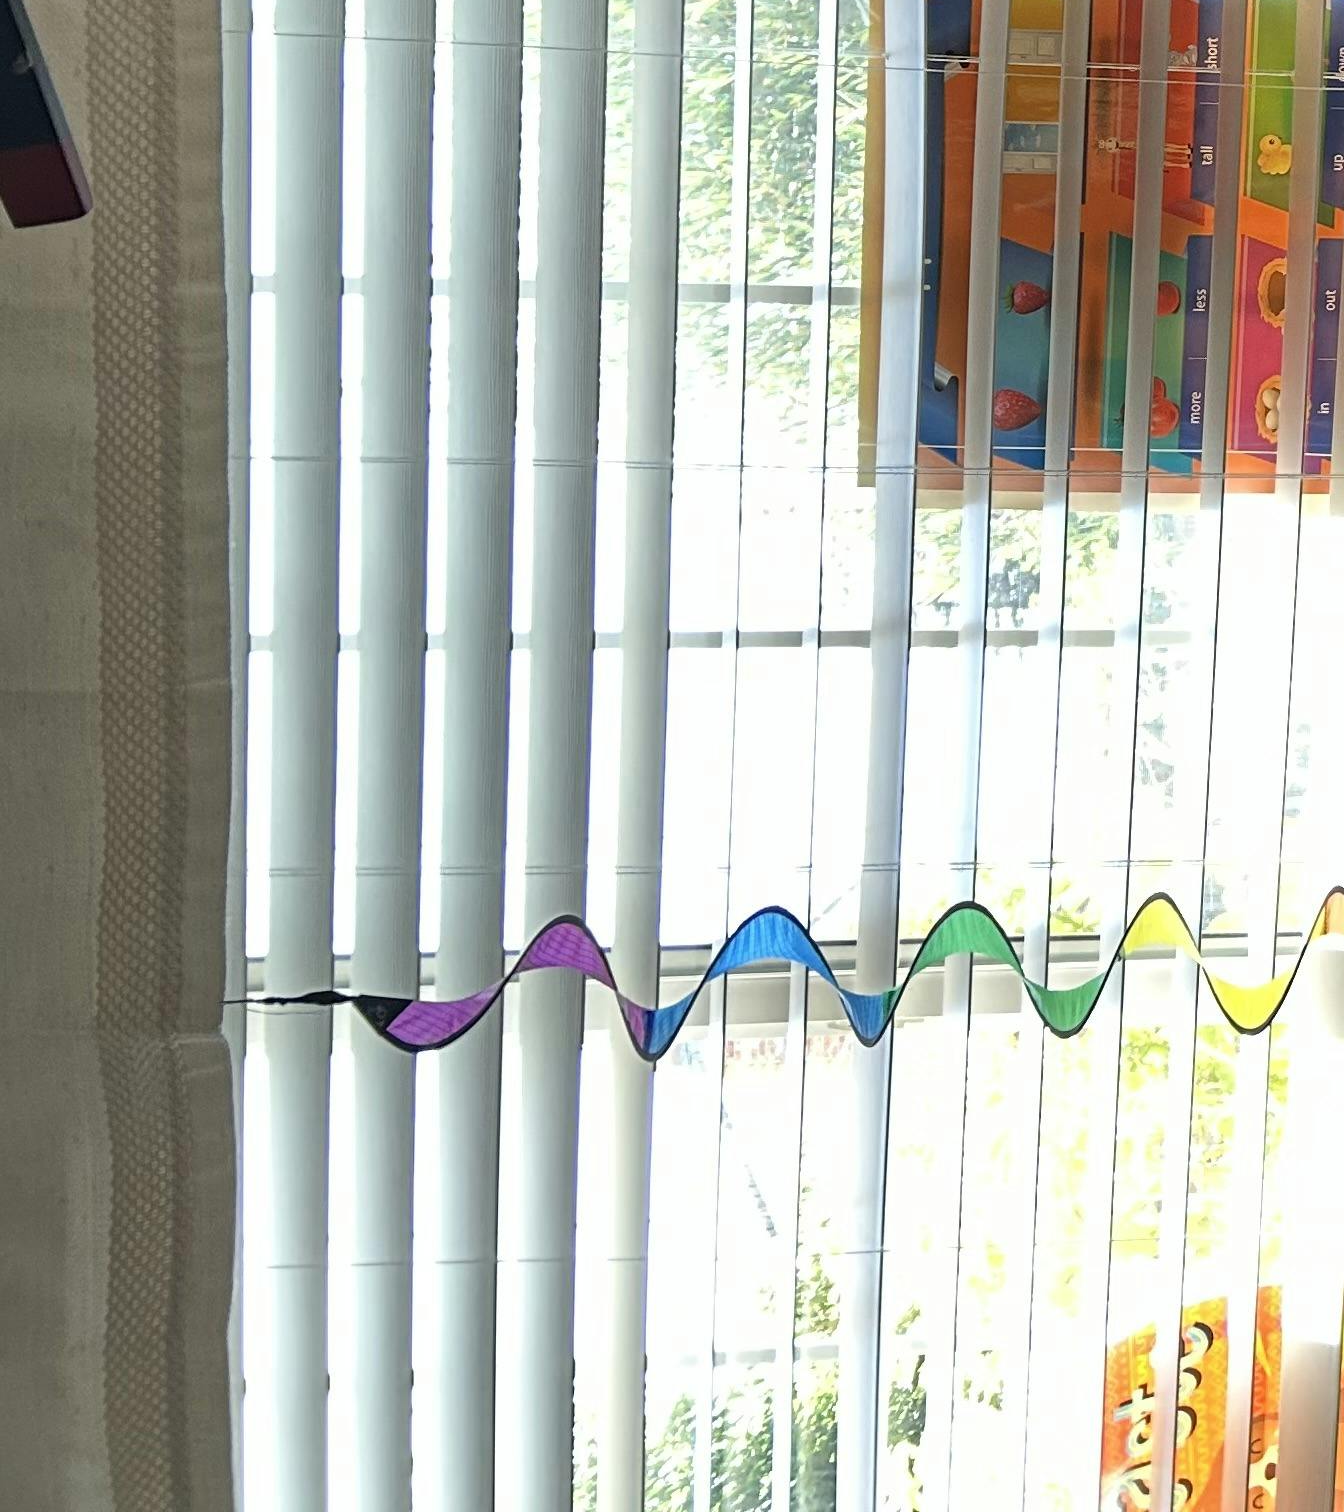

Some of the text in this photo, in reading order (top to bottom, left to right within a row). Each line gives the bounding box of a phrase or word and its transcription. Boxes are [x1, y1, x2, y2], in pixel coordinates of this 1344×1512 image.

[1204, 37, 1219, 70] short
[1199, 145, 1214, 166] tall
[1192, 288, 1208, 312] less
[1323, 290, 1337, 311] out
[1188, 391, 1202, 424] more
[1317, 402, 1331, 414] in
